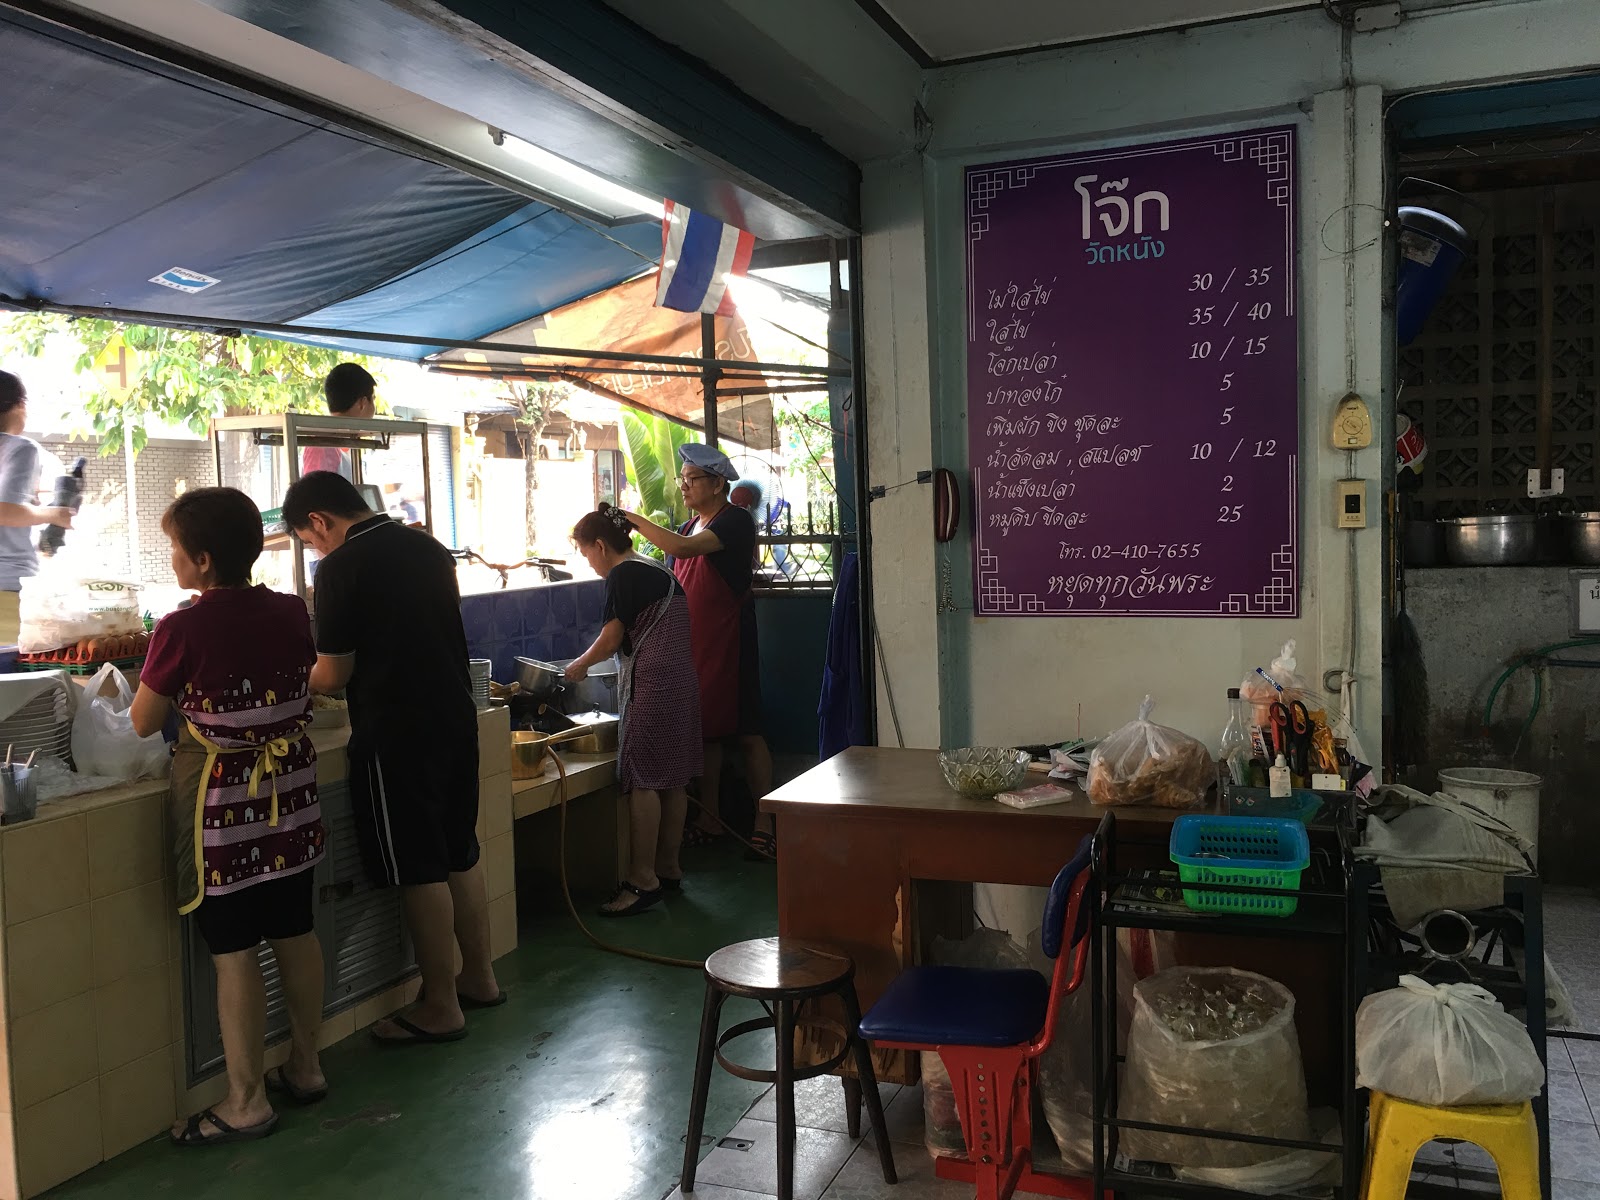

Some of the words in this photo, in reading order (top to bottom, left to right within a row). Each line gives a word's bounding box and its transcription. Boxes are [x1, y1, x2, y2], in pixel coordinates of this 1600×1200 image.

[1074, 174, 1170, 240] โจ๊ก
[1085, 236, 1166, 265] วัดหนัง
[987, 276, 1057, 311] ไม่ใส่ไข่
[1188, 272, 1213, 292] 30
[1221, 267, 1236, 293] /
[1245, 266, 1272, 286] 35
[986, 311, 1035, 344] ใส่ไข่
[1189, 305, 1216, 326] 35
[1223, 301, 1239, 327] /
[1247, 301, 1271, 321] 40
[987, 341, 1057, 377] โจ๊กเปล่า
[1188, 341, 1211, 360] 10
[1219, 336, 1235, 361] /
[1243, 335, 1270, 356] 15
[986, 374, 1068, 407] ปาท่องโก๋
[1220, 372, 1234, 391] 5
[986, 409, 1041, 437] เพิ่มผัก
[1046, 412, 1068, 433] ขิง
[1074, 414, 1123, 443] ชุดละ
[1220, 406, 1234, 425] 5
[986, 441, 1063, 471] น้ำอัดลม
[1189, 442, 1212, 461] 10
[1228, 437, 1244, 463] /
[1252, 439, 1277, 458] 12
[987, 469, 1076, 501] น้ำแข็งเปล่า
[1221, 475, 1234, 493] 2
[989, 505, 1039, 537] หมูดิบ
[1040, 505, 1090, 530] ขีดละ
[1216, 504, 1244, 523] 25
[1058, 541, 1086, 559] โทร.
[1091, 542, 1202, 559] 02-410-7655
[1047, 565, 1216, 609] หยุดทุกวันพระ
